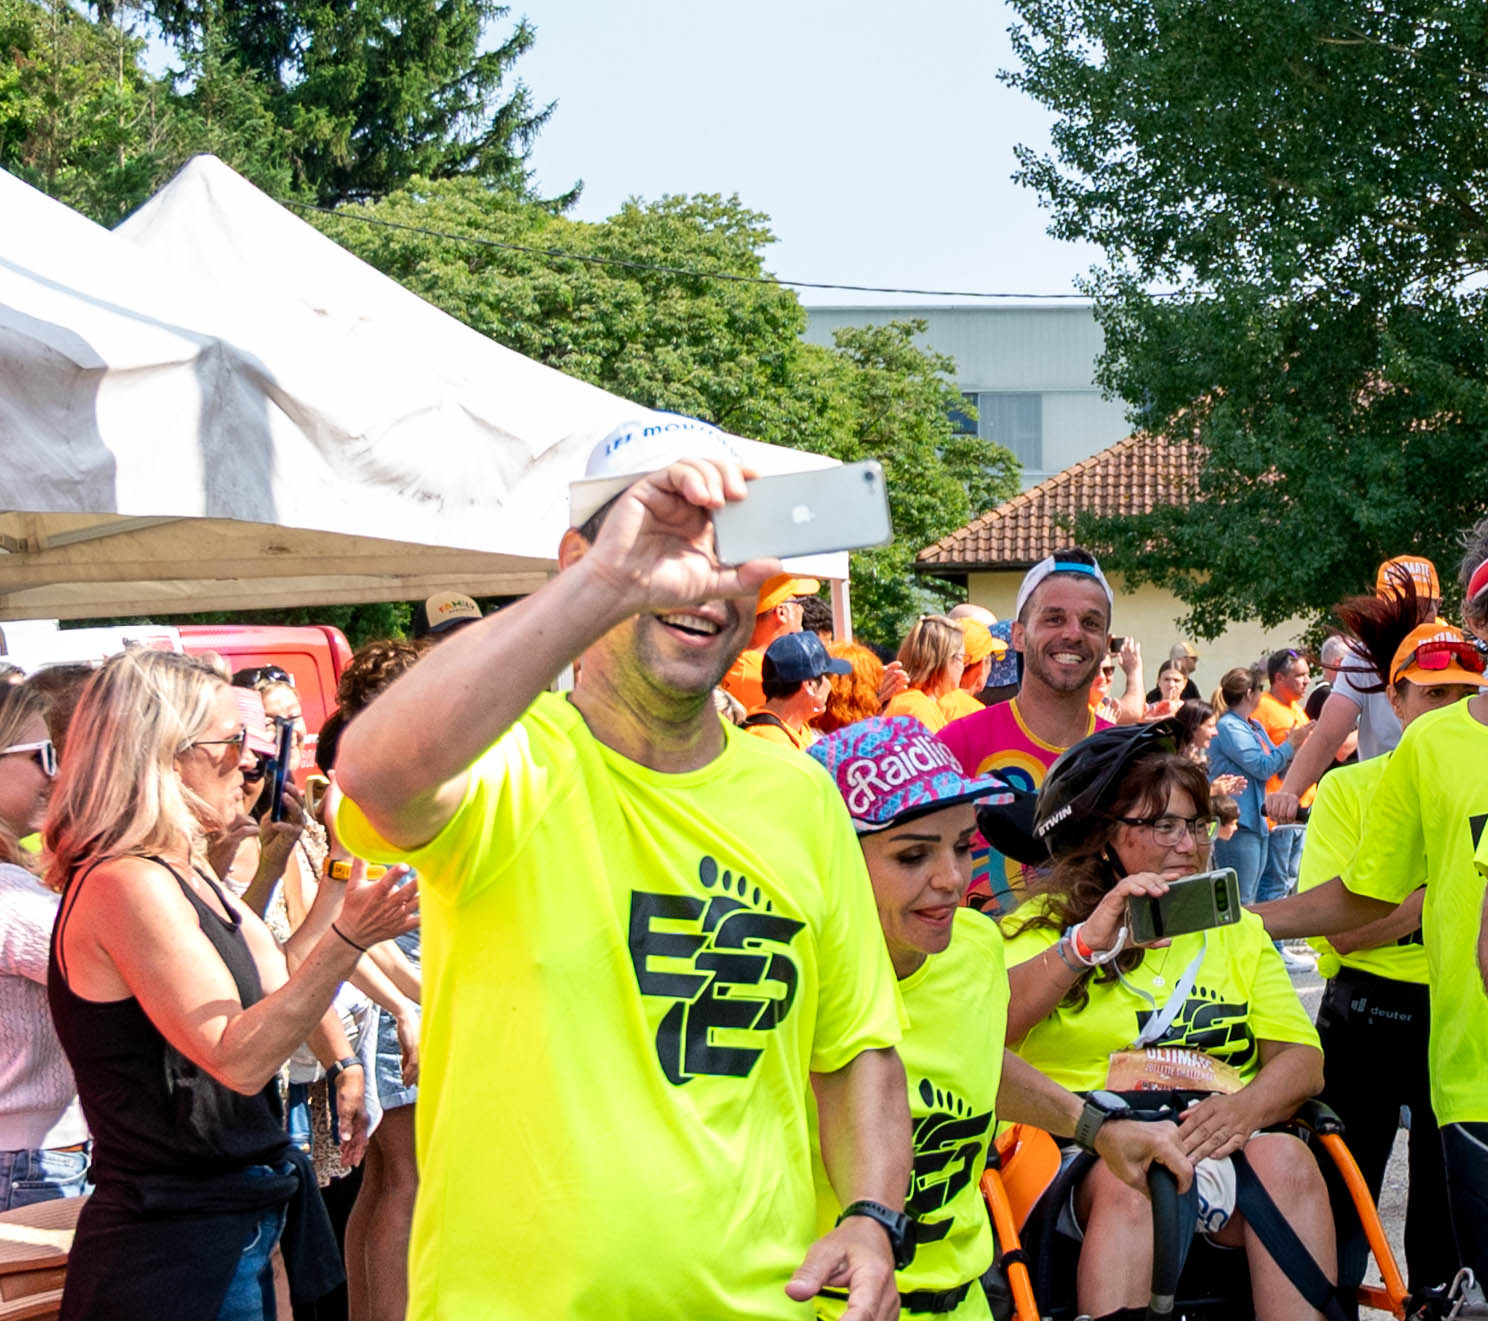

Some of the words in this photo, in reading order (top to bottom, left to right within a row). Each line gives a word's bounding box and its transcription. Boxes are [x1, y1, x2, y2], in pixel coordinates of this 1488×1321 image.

[846, 735, 964, 814] Raidlig
[1037, 805, 1073, 837] BTWIN
[1371, 1007, 1413, 1022] deuter
